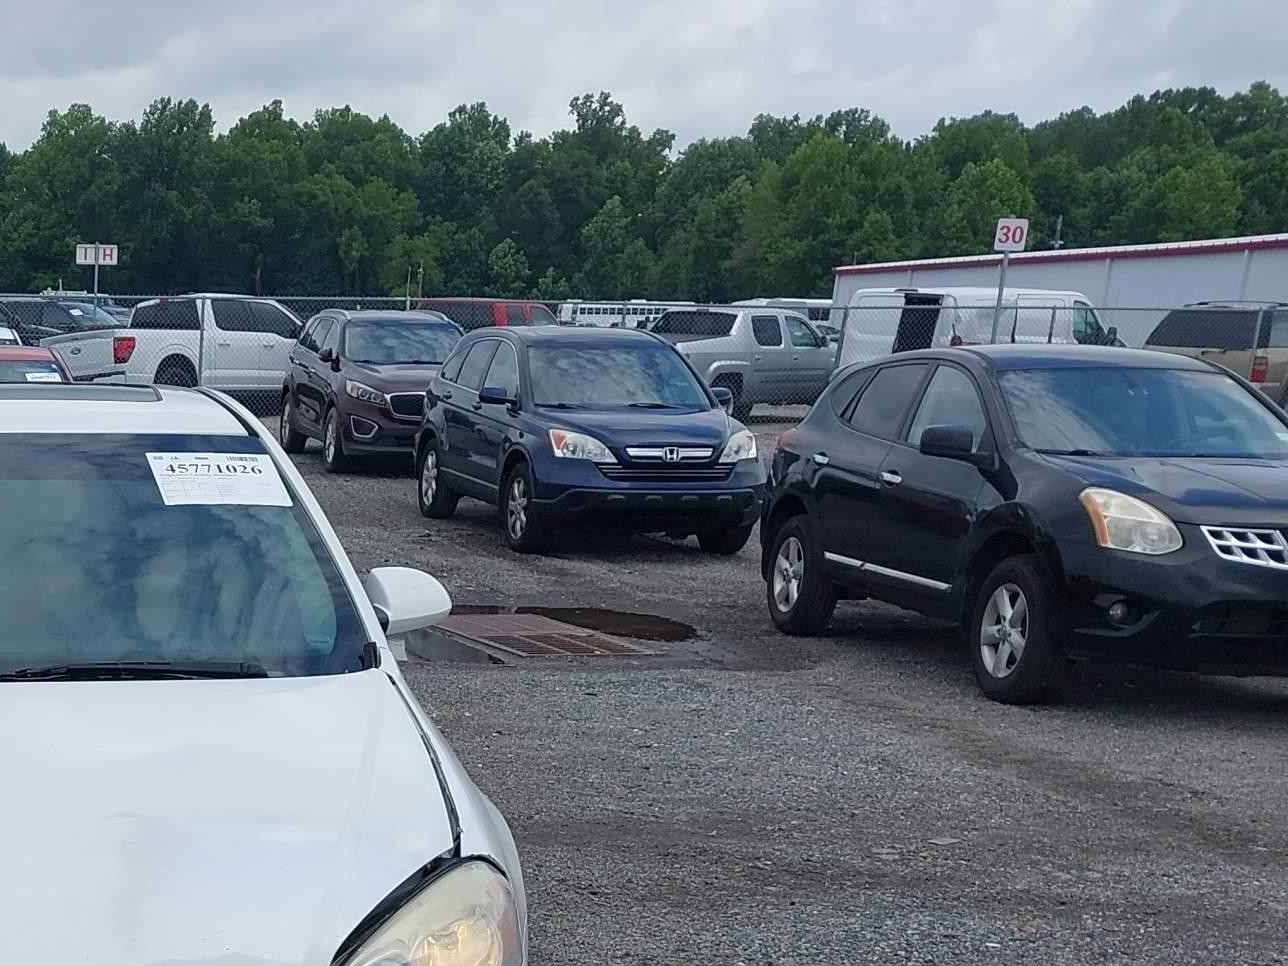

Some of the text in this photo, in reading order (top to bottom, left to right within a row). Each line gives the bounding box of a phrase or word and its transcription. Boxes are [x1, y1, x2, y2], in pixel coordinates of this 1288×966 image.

[998, 225, 1024, 244] 30
[102, 246, 114, 261] H
[165, 463, 263, 475] 45771026
